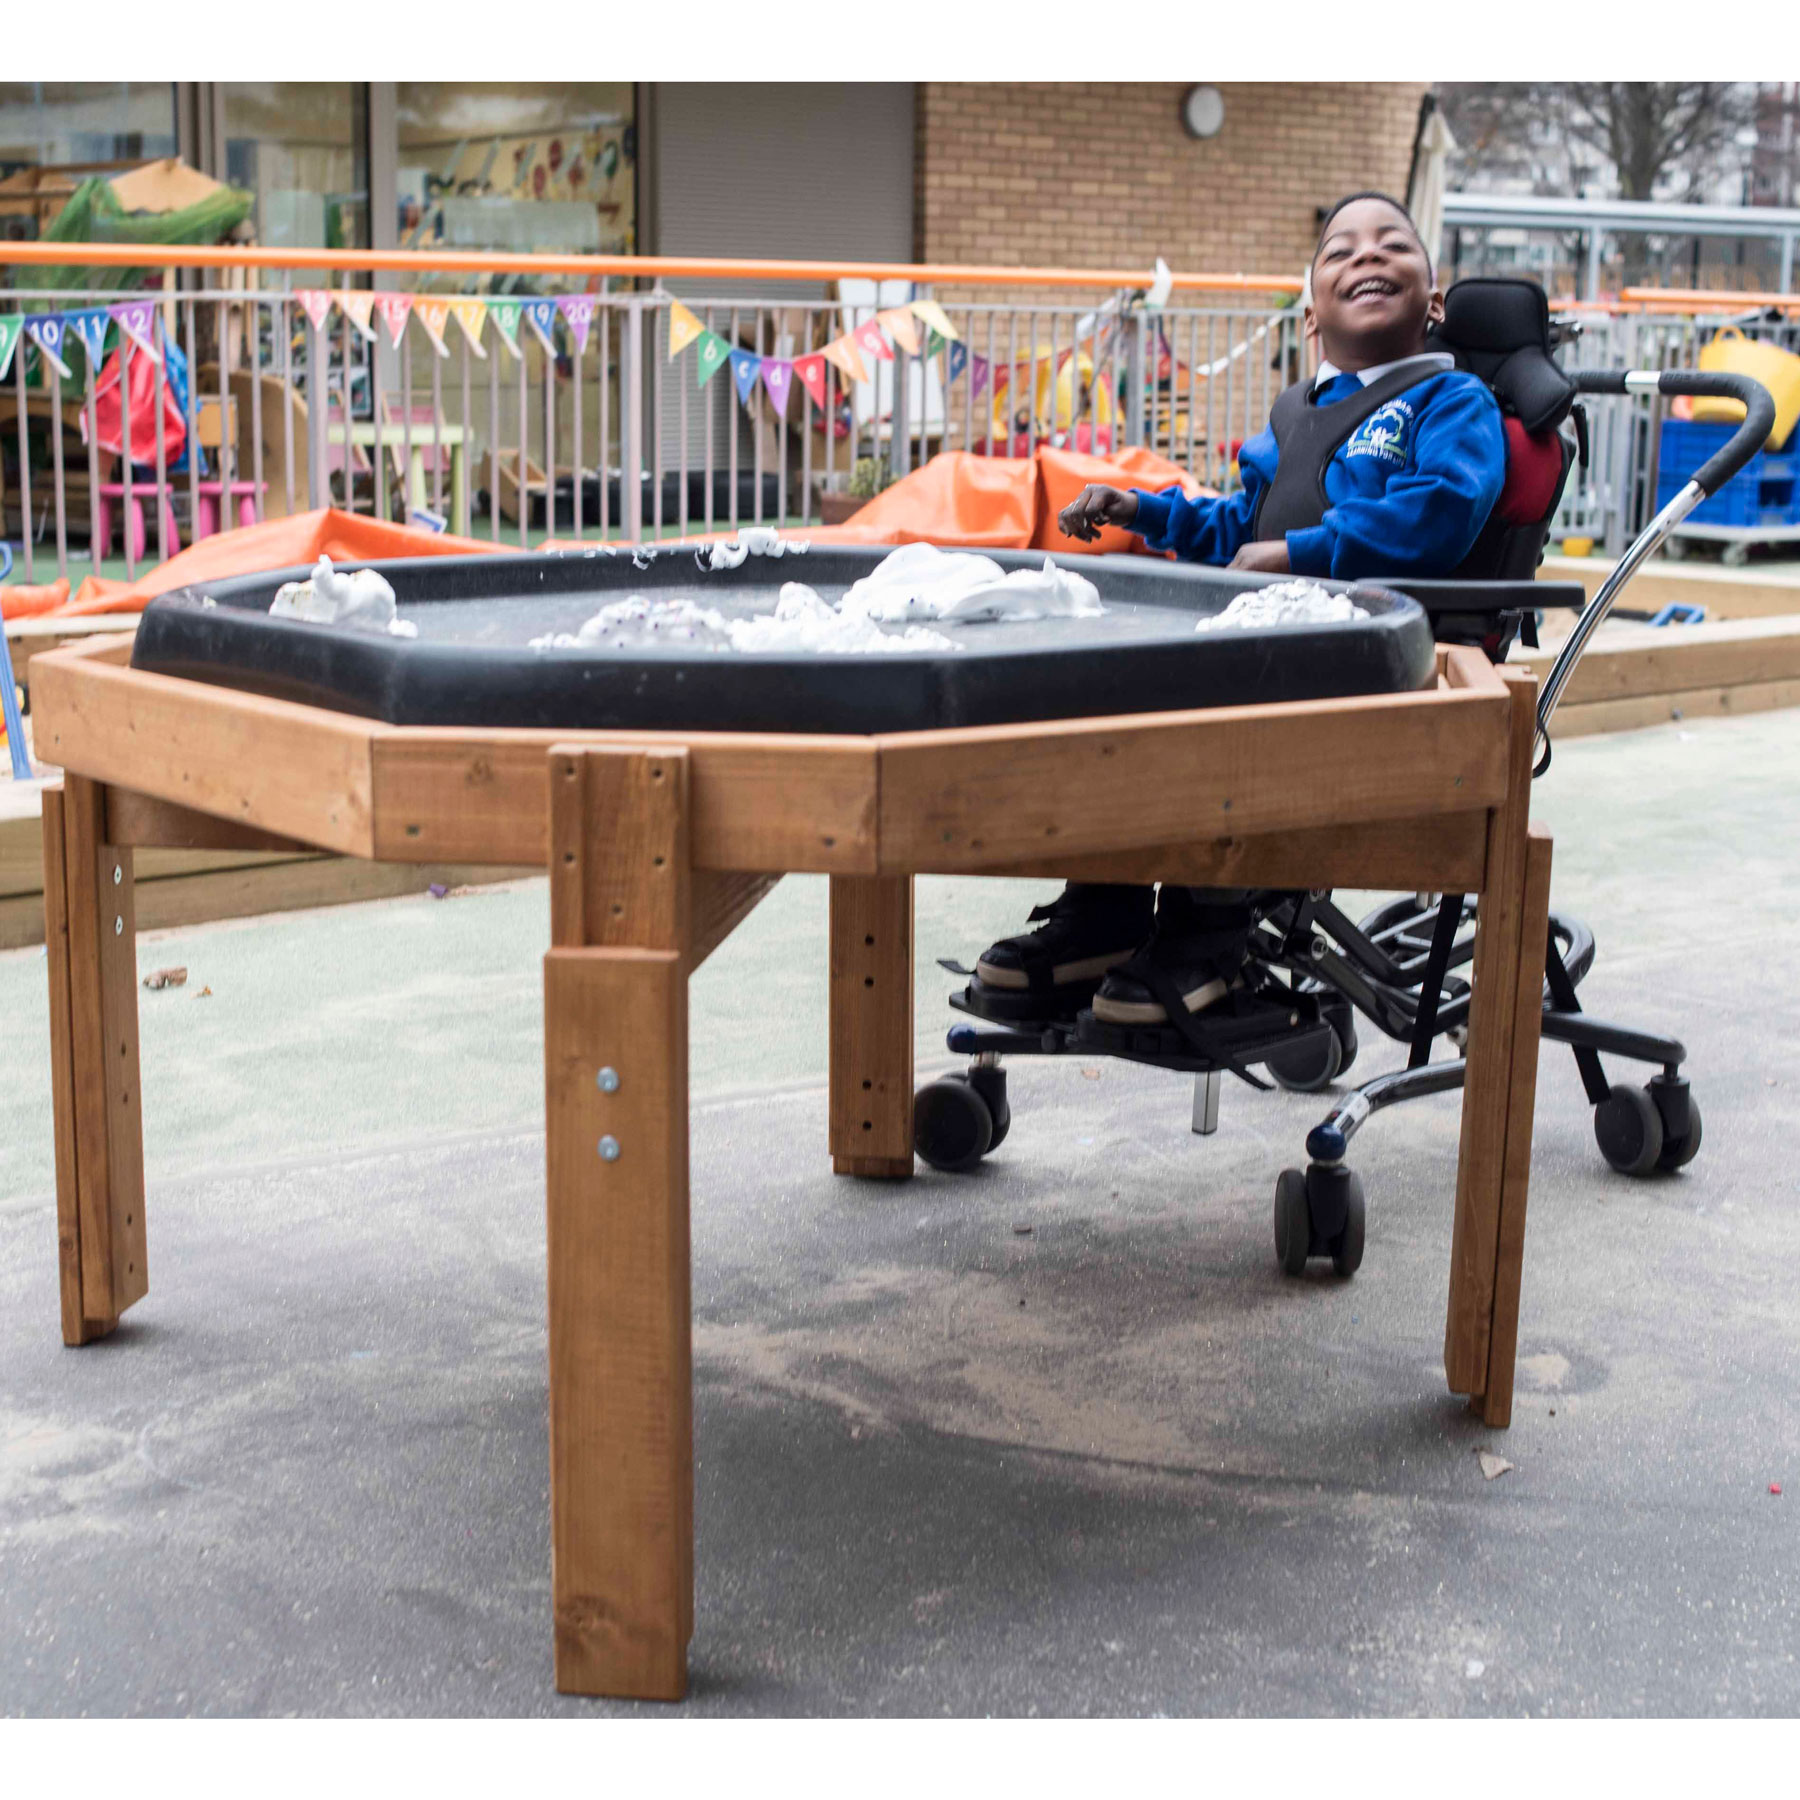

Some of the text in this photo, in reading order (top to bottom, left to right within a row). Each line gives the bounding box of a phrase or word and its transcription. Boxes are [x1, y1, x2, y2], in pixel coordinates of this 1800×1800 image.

[30, 320, 59, 345] 10
[77, 315, 101, 341] 11
[119, 309, 146, 332] 12
[419, 304, 443, 326] 16
[457, 305, 478, 325] 17
[493, 305, 514, 328] 18
[528, 303, 550, 325] 19
[567, 302, 591, 325] 20
[702, 339, 717, 362] b
[738, 360, 750, 379] c
[770, 364, 783, 387] d
[806, 364, 817, 382] e
